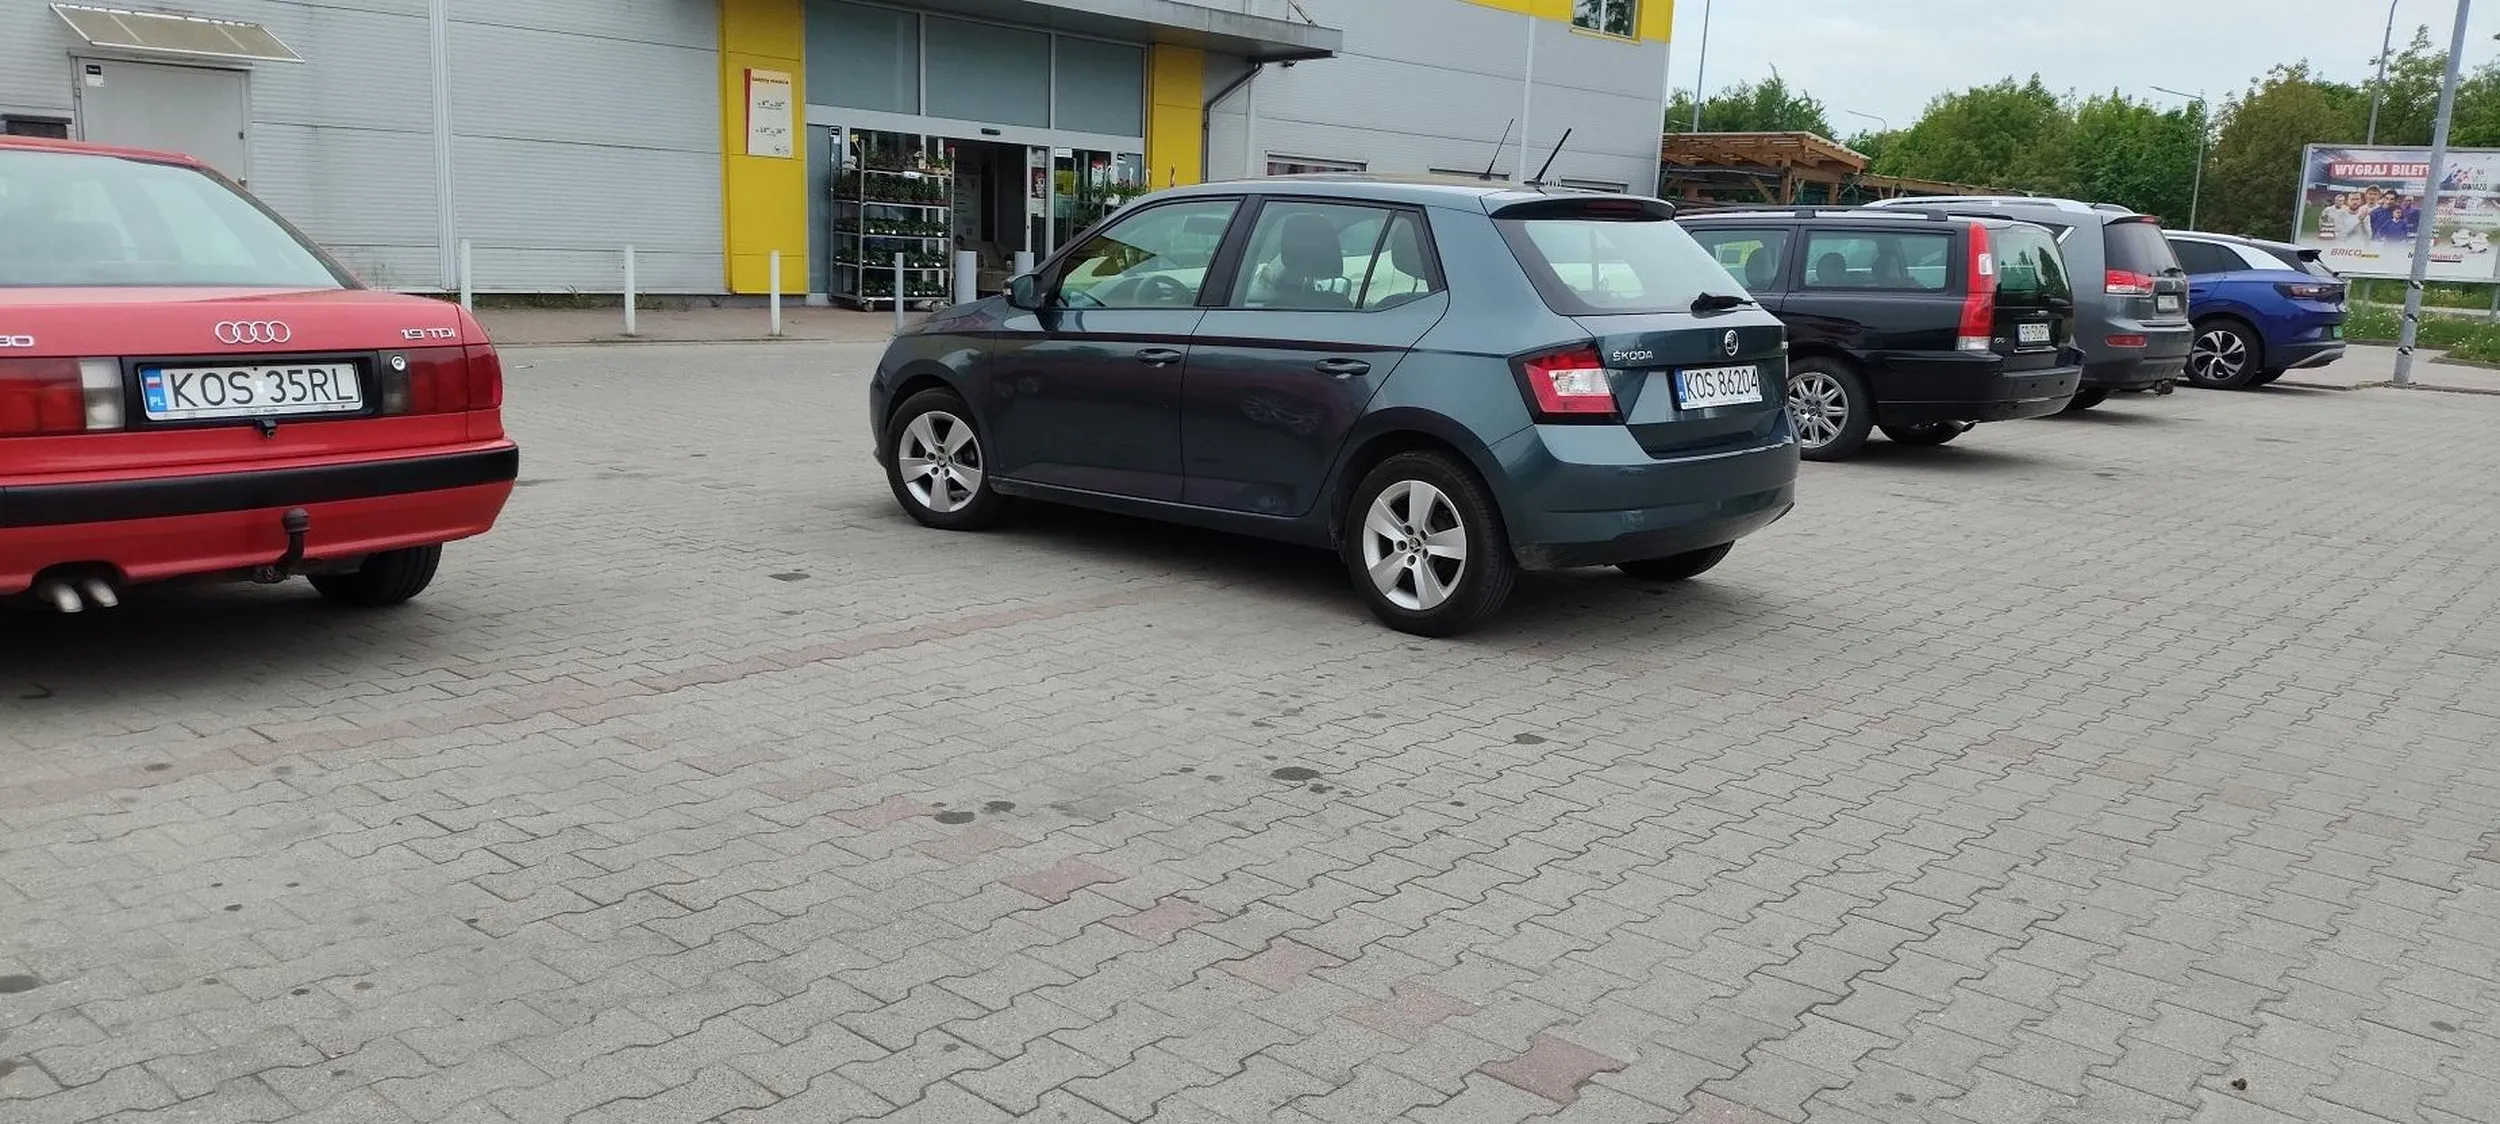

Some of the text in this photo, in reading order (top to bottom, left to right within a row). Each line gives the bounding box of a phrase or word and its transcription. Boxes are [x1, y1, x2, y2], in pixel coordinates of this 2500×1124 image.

[2335, 164, 2388, 175] WYGRAJ
[426, 327, 456, 338] TDI
[169, 368, 354, 408] KOS 35RL
[1684, 366, 1761, 400] KOS 86204
[150, 396, 164, 406] PL
